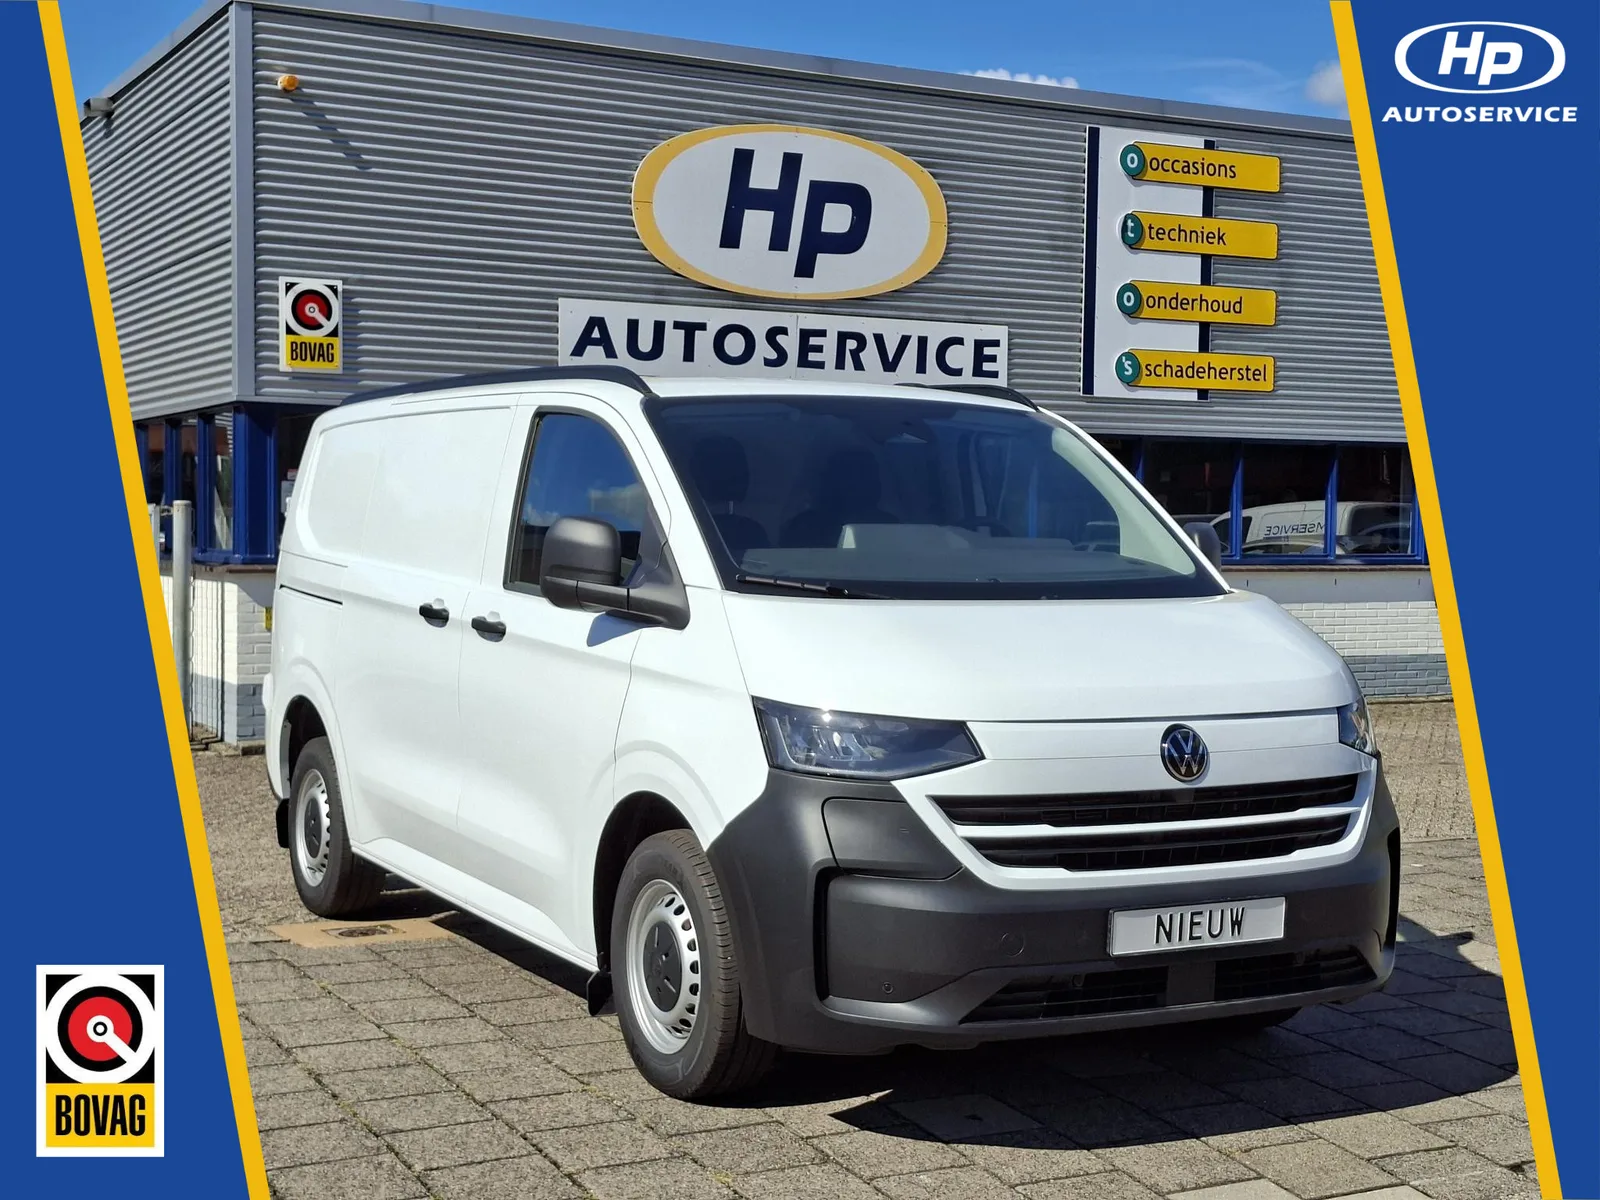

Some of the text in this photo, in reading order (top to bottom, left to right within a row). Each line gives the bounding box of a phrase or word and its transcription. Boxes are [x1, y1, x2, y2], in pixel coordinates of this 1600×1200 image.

[1149, 157, 1237, 179] occasions
[1148, 223, 1227, 246] techniek
[1146, 292, 1243, 314] onderhoud
[290, 341, 335, 363] BOVAG
[570, 316, 1001, 379] AUTOSERVICE
[1144, 360, 1267, 382] schadeherstel
[1155, 906, 1245, 945] NIEUW
